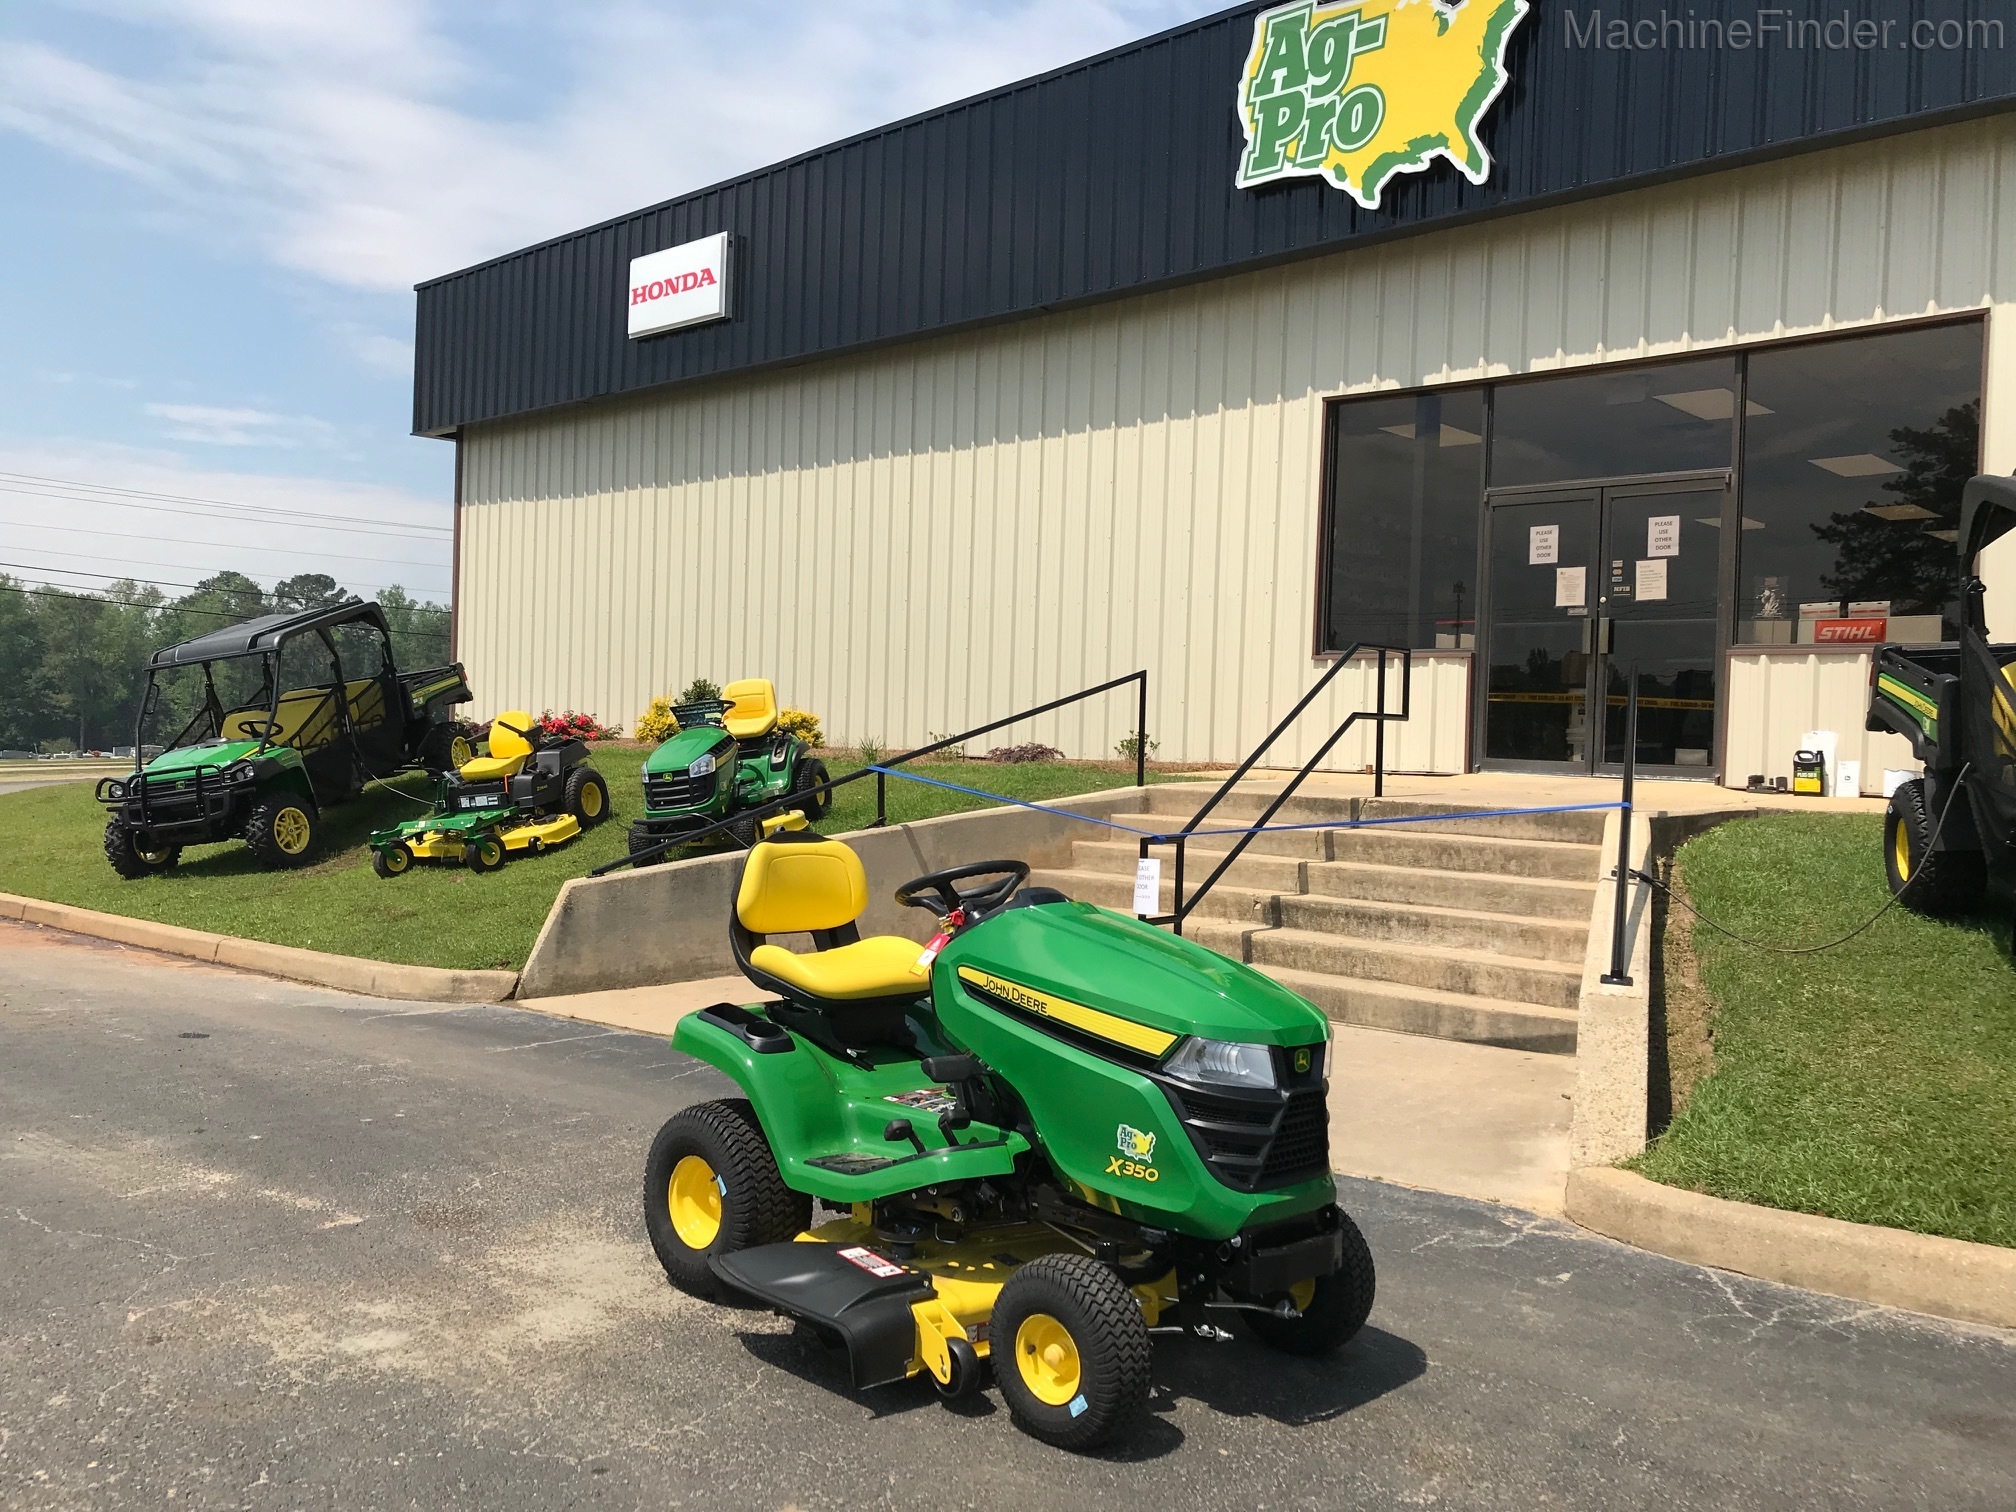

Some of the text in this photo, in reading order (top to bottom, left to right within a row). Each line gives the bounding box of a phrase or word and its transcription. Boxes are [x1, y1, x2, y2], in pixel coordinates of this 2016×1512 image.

[1249, 6, 1387, 102] Ag-
[1246, 86, 1385, 176] Pro
[631, 267, 717, 306] HONDA
[1818, 626, 1876, 640] STIHL
[982, 975, 1048, 1015] JOHN DEERE
[1119, 1137, 1137, 1150] Pro
[1104, 1155, 1159, 1182] X350
